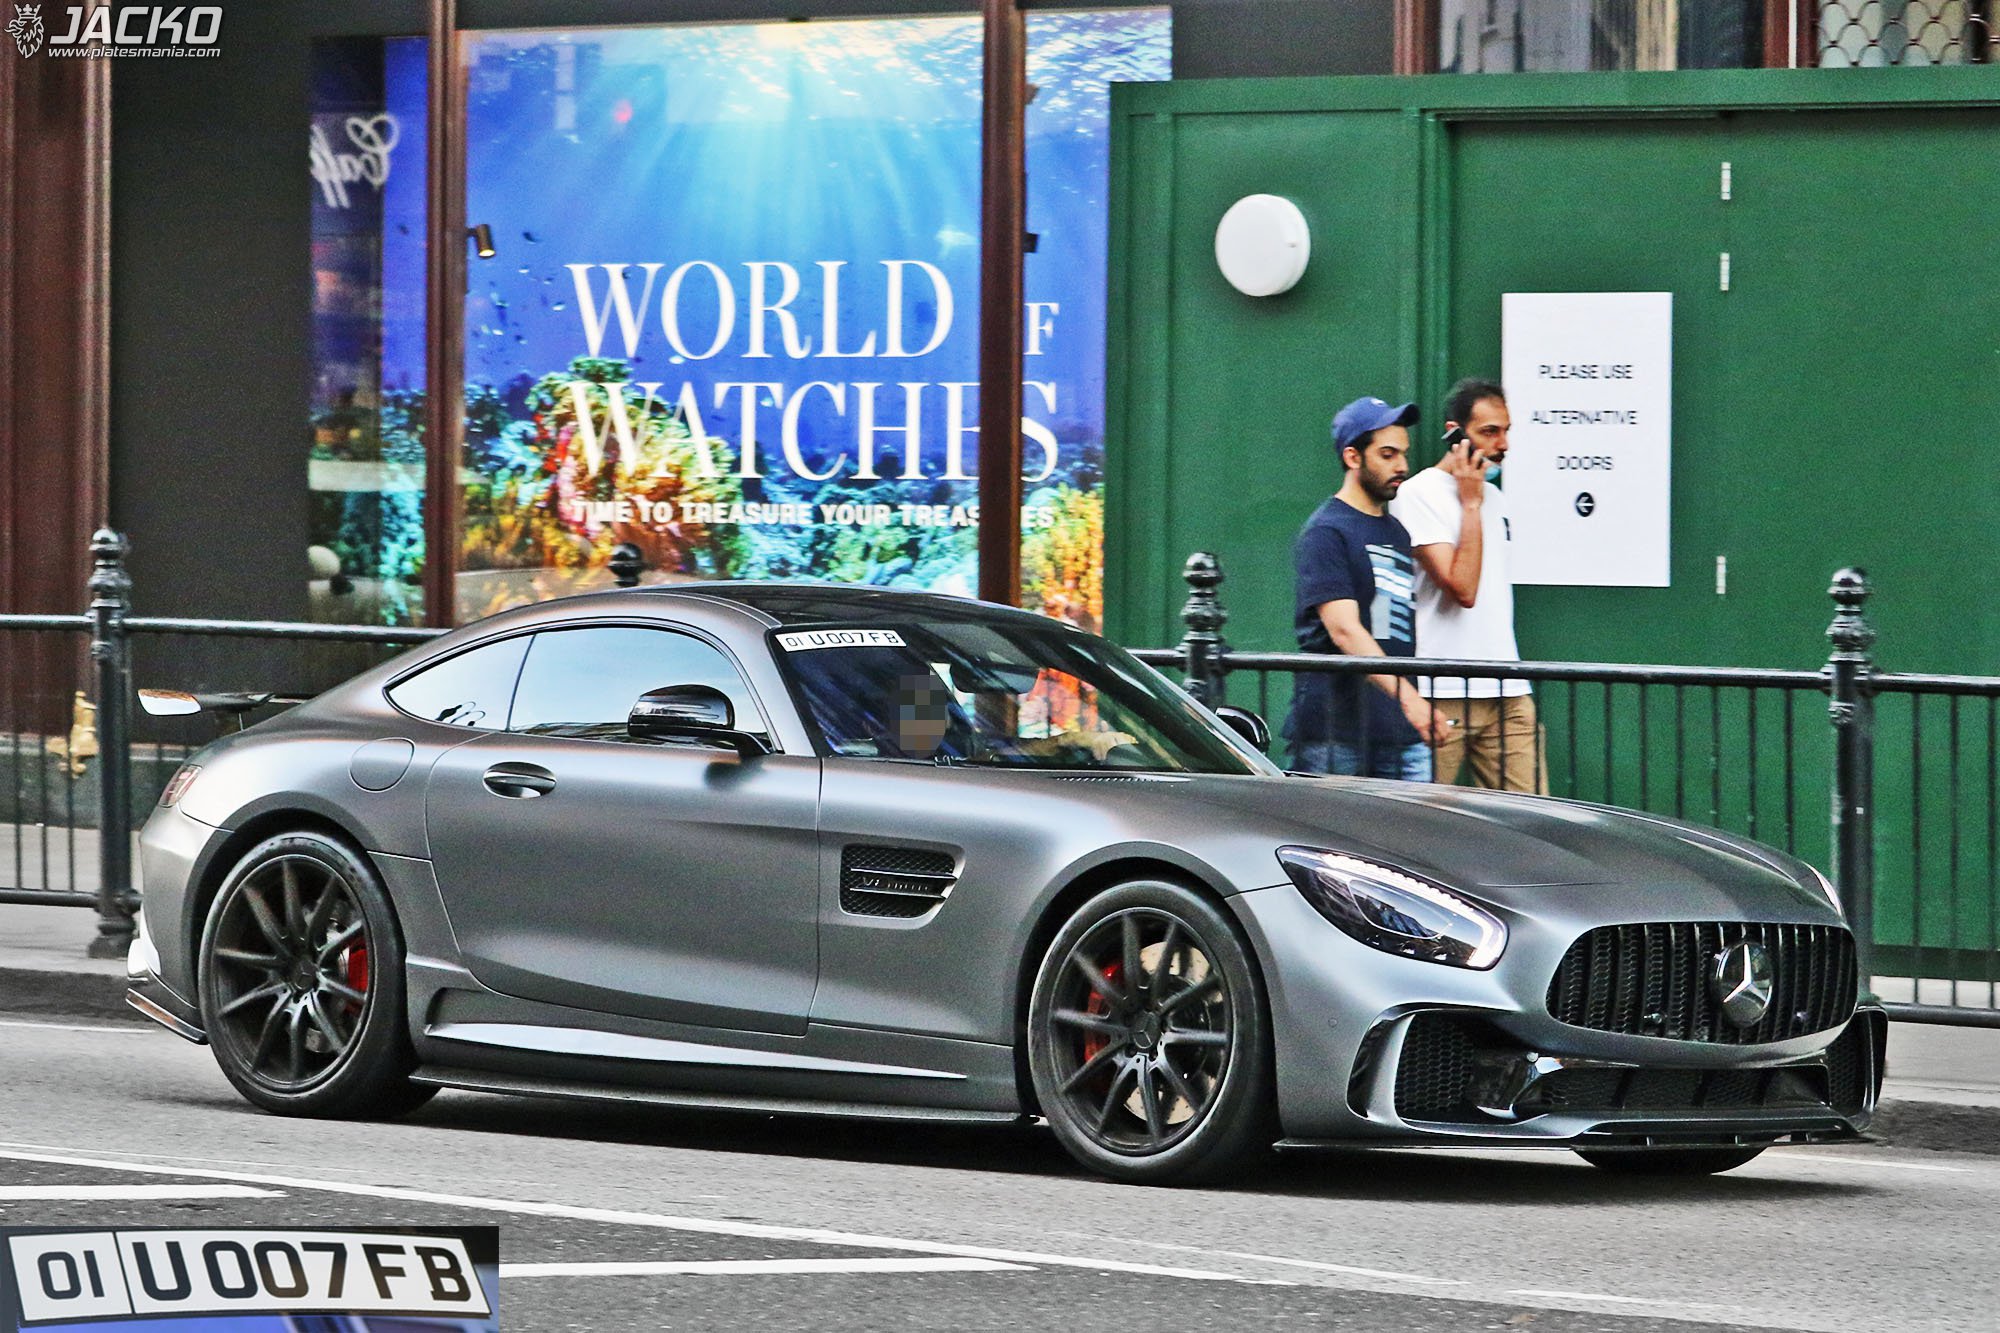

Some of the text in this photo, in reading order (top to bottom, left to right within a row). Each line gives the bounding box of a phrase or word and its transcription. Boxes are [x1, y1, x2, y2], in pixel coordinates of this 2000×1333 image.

[564, 260, 954, 360] WORLD
[1539, 364, 1634, 379] PLEASE USE
[1531, 409, 1638, 424] ALTERNATIVE
[566, 381, 1059, 483] WATCHES
[1556, 455, 1614, 471] DOORS
[571, 500, 1054, 528] TIME TO TREASURE YOUR TREASES
